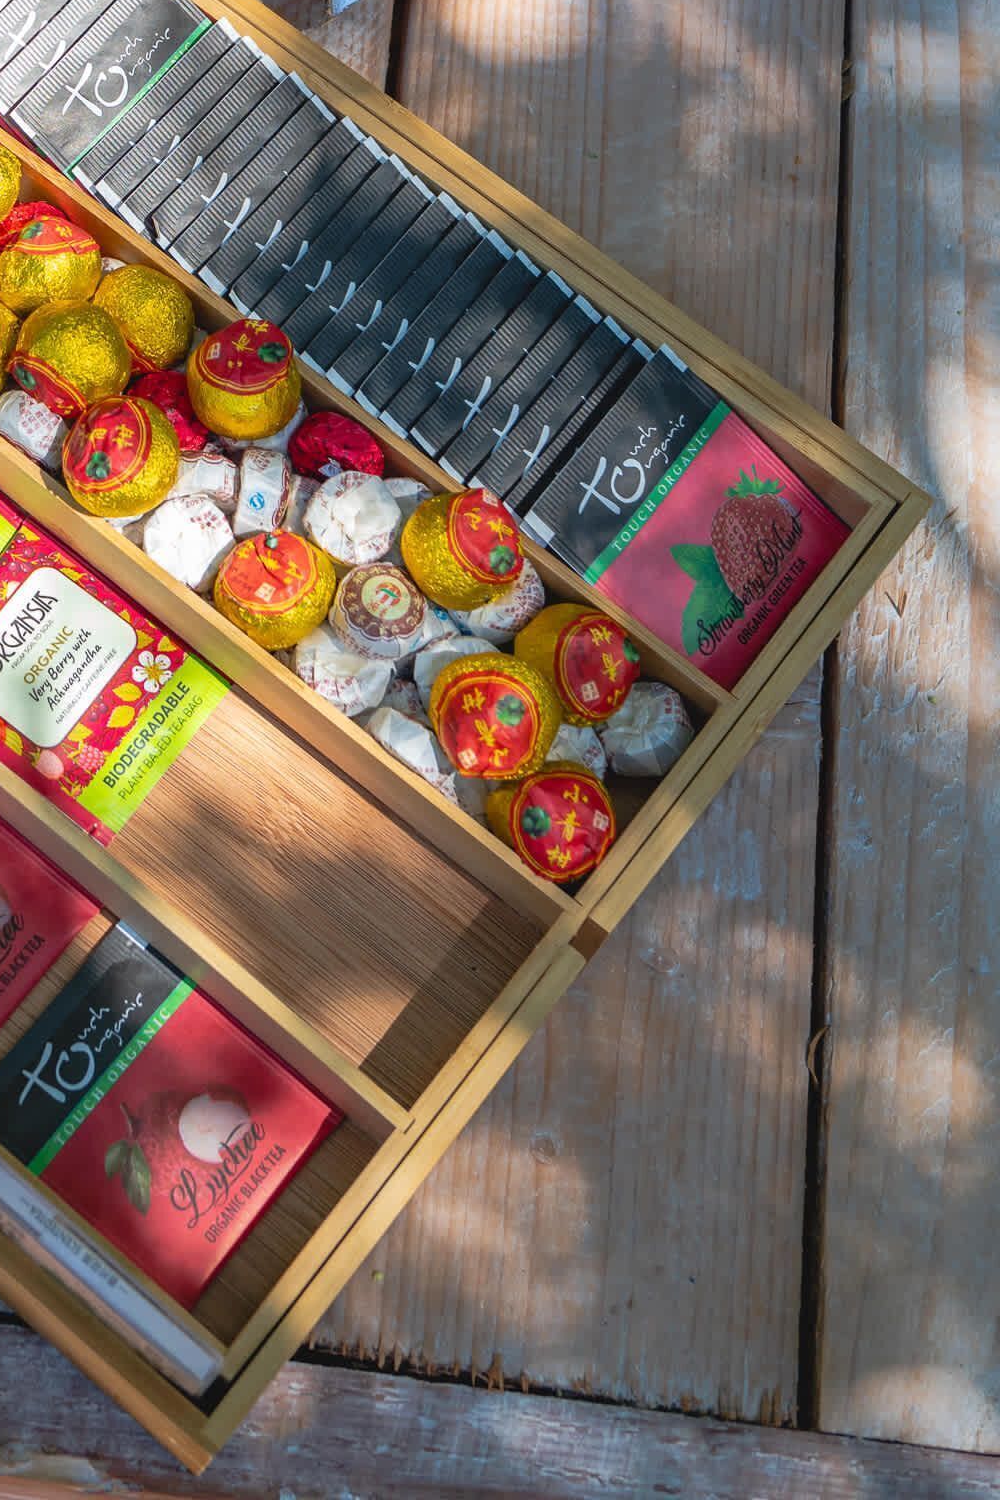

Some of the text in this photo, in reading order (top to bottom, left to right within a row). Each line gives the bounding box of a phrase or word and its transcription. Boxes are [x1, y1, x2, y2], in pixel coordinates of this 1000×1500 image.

[612, 426, 711, 551] TOUCH ORGANIC
[697, 508, 807, 652] Strawberry Mint
[735, 556, 807, 645] ORGANIC GREEN TEA
[9, 650, 27, 670] FROM
[33, 631, 43, 642] TO
[21, 624, 74, 686] ORGANIC
[28, 627, 93, 702] Very Berry with
[48, 643, 103, 712] Ashwagandha
[53, 647, 119, 724] NATURALLY CAFFEINE-FREE
[102, 680, 191, 789] BIODEGRADABLE
[117, 694, 204, 800] PLANT BASED TEA BAG
[22, 933, 46, 958] TEA
[52, 1086, 106, 1146] TOUCH
[106, 1007, 172, 1083] ORGANIC
[172, 1120, 261, 1230] Lychee
[203, 1142, 286, 1243] ORGANIC BLACK TEA
